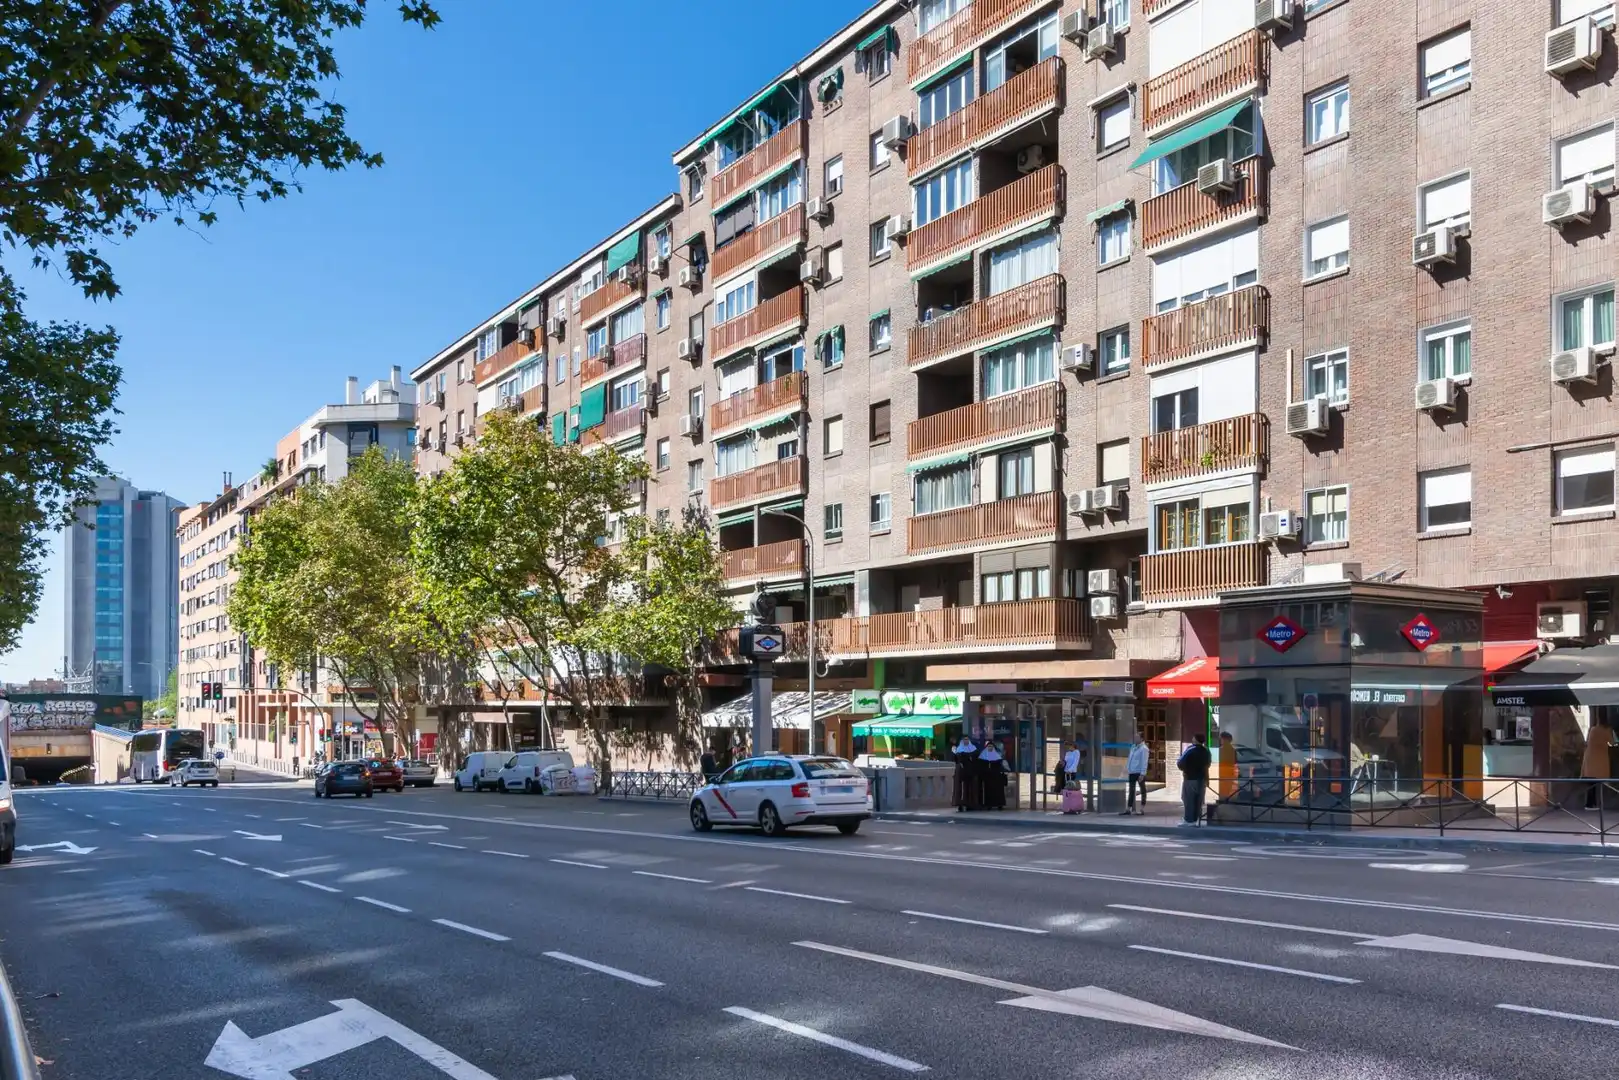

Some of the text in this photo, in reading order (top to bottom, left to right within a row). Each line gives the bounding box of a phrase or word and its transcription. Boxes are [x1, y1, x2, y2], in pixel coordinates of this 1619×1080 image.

[1269, 629, 1291, 638] Metro
[1413, 628, 1430, 637] Metro
[1496, 696, 1525, 705] AMSTEL
